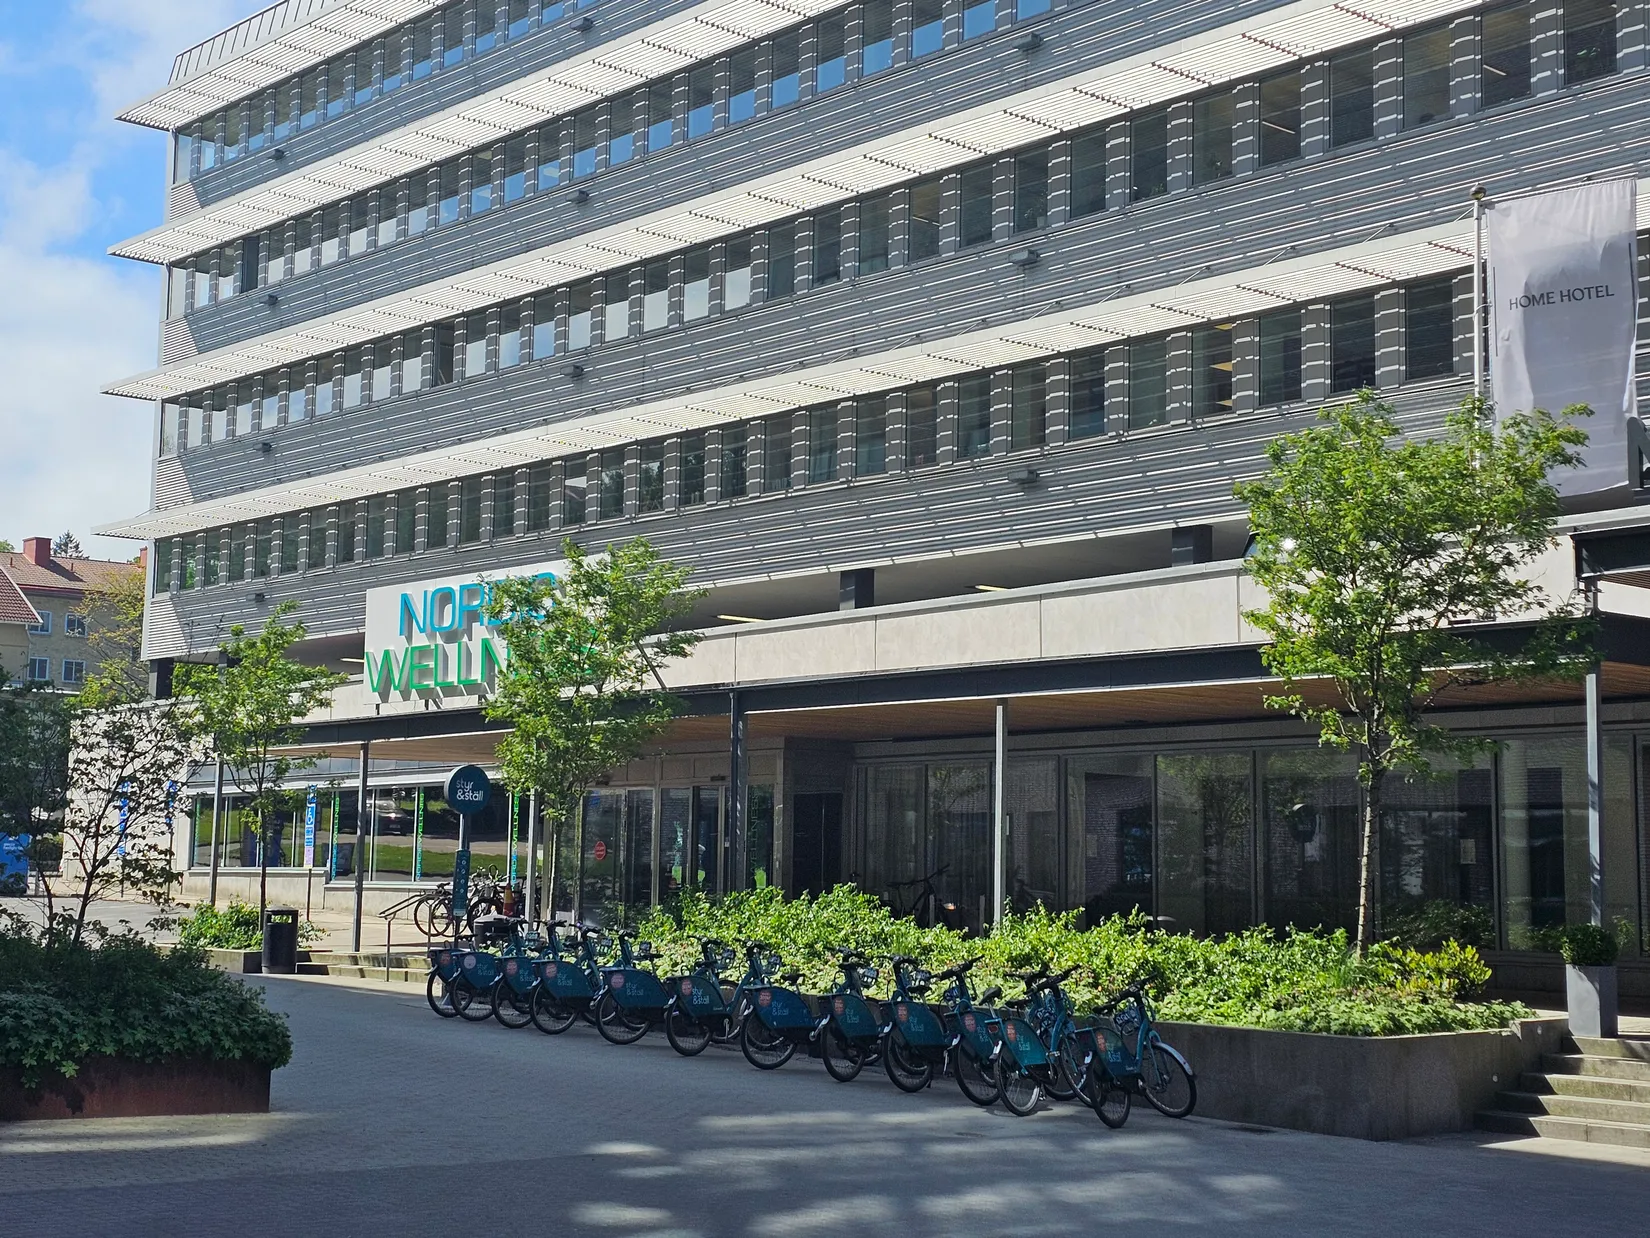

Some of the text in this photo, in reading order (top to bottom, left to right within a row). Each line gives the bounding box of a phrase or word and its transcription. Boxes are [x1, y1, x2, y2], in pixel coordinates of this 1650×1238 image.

[1508, 284, 1615, 311] HOME HOTEL
[398, 571, 558, 637] NORDC
[456, 777, 474, 794] styr
